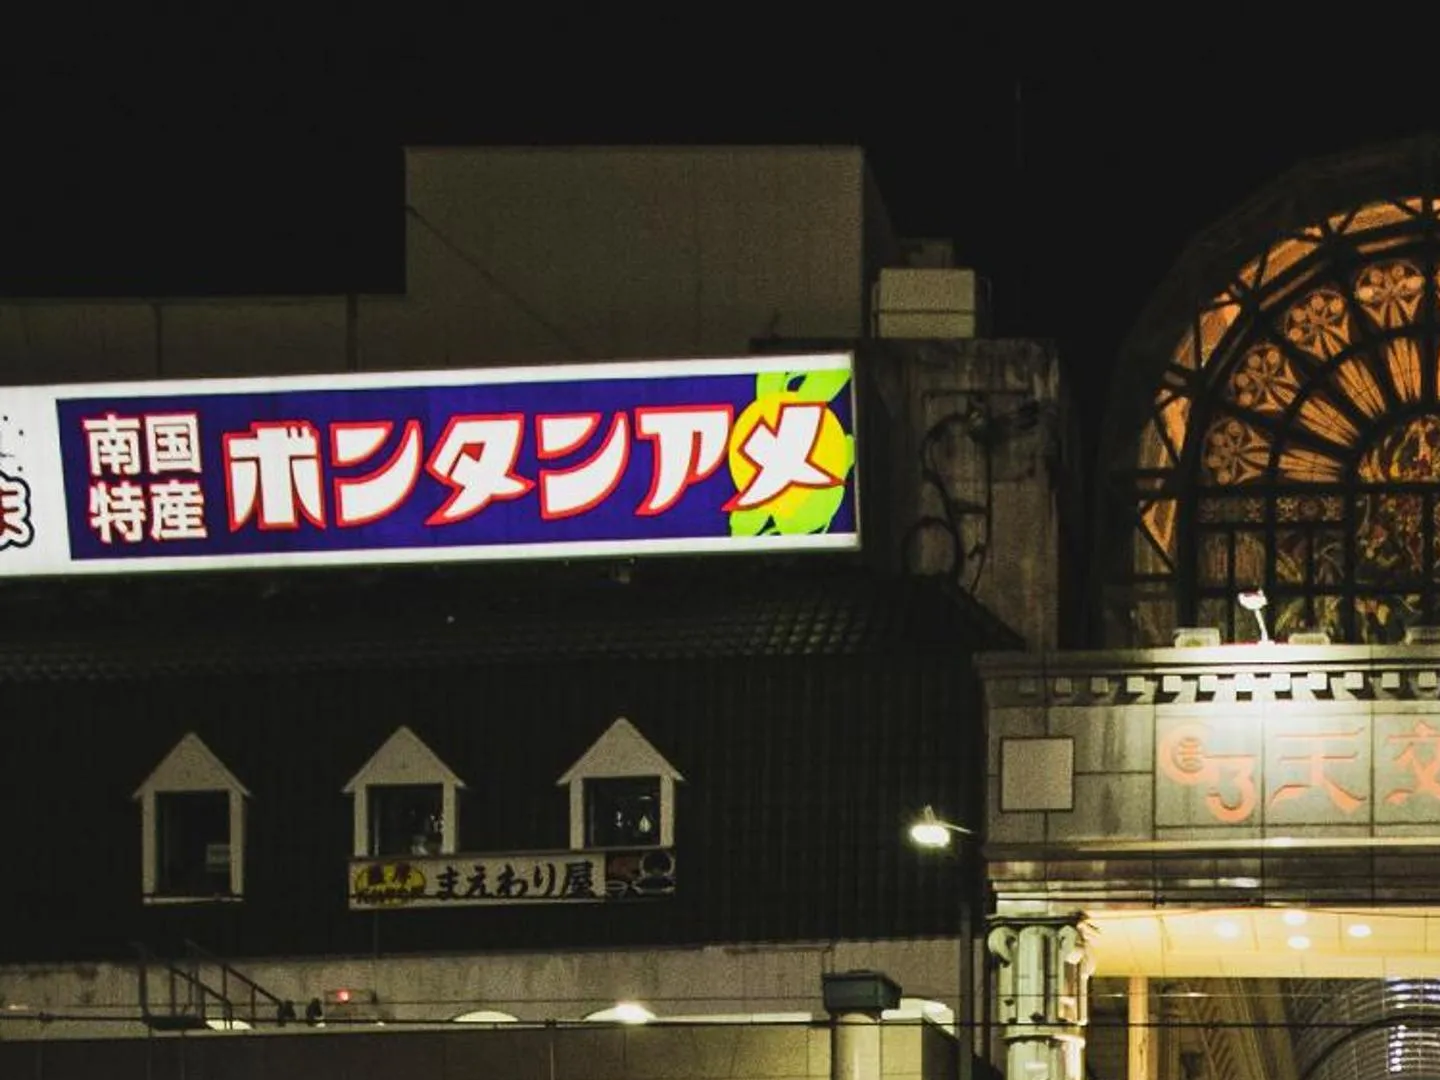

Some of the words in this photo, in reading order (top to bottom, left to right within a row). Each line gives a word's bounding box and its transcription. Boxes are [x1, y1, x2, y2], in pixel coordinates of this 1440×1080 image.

[84, 413, 202, 475] 南国
[223, 402, 845, 533] ボンタンアメ
[89, 480, 207, 544] 特産
[434, 858, 602, 900] まえわり屋
